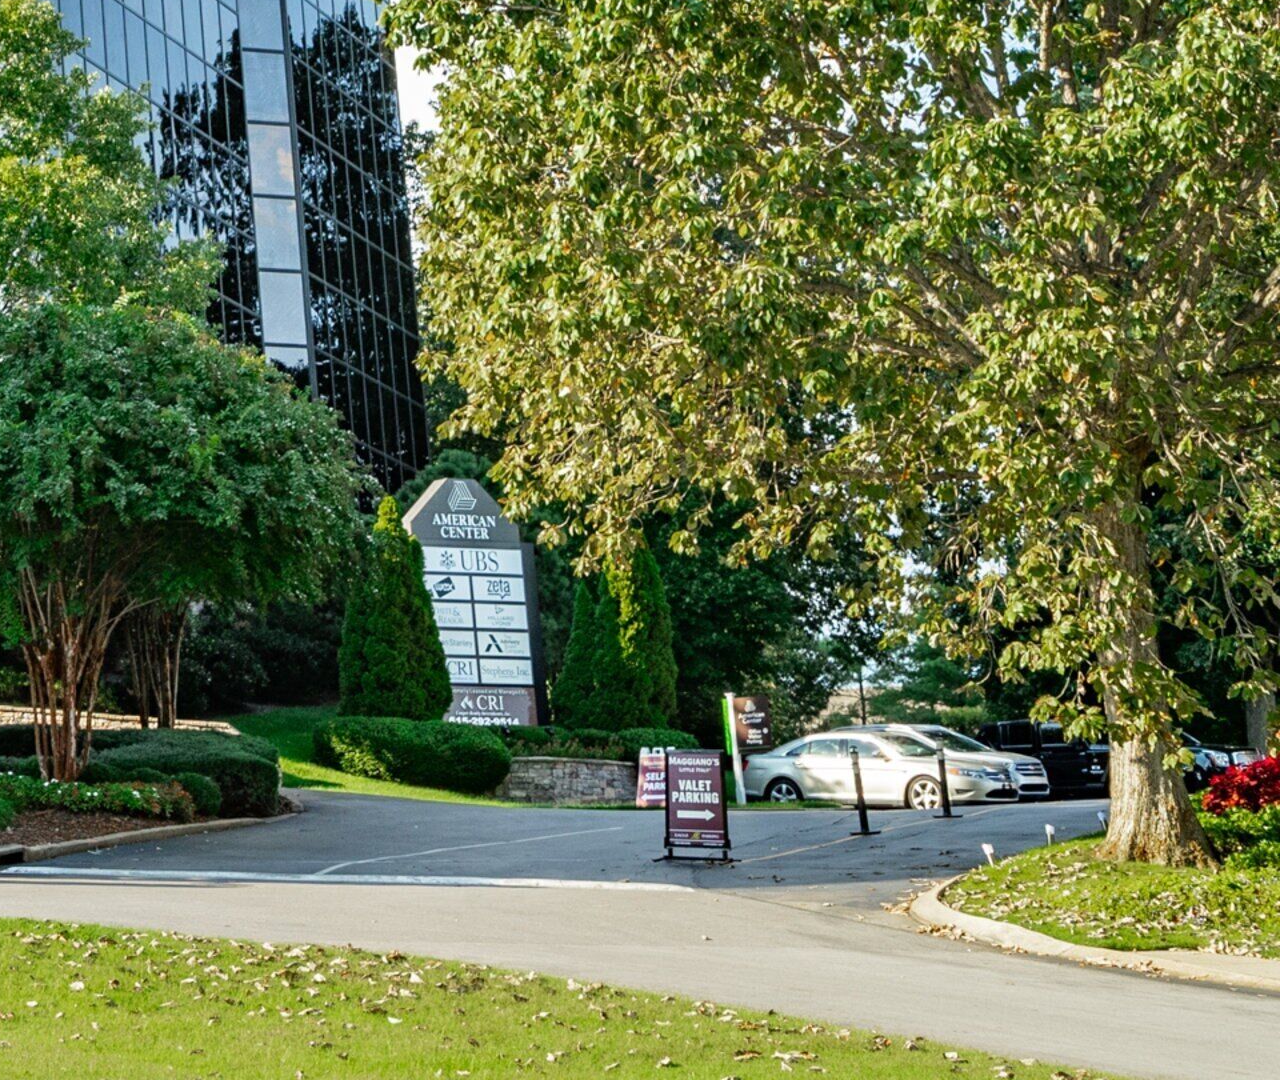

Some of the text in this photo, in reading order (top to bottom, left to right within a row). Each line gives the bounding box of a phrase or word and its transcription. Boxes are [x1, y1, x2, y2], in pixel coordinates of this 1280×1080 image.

[432, 513, 496, 527] AMERICAN
[440, 526, 490, 539] CENTER
[460, 550, 500, 572] UBS
[486, 579, 511, 593] zeta
[447, 660, 473, 676] CRI
[476, 695, 505, 710] CRI
[668, 756, 720, 767] MAGGIANO'S
[645, 772, 666, 781] SELF
[678, 779, 712, 791] VALET
[671, 791, 720, 804] PARKING
